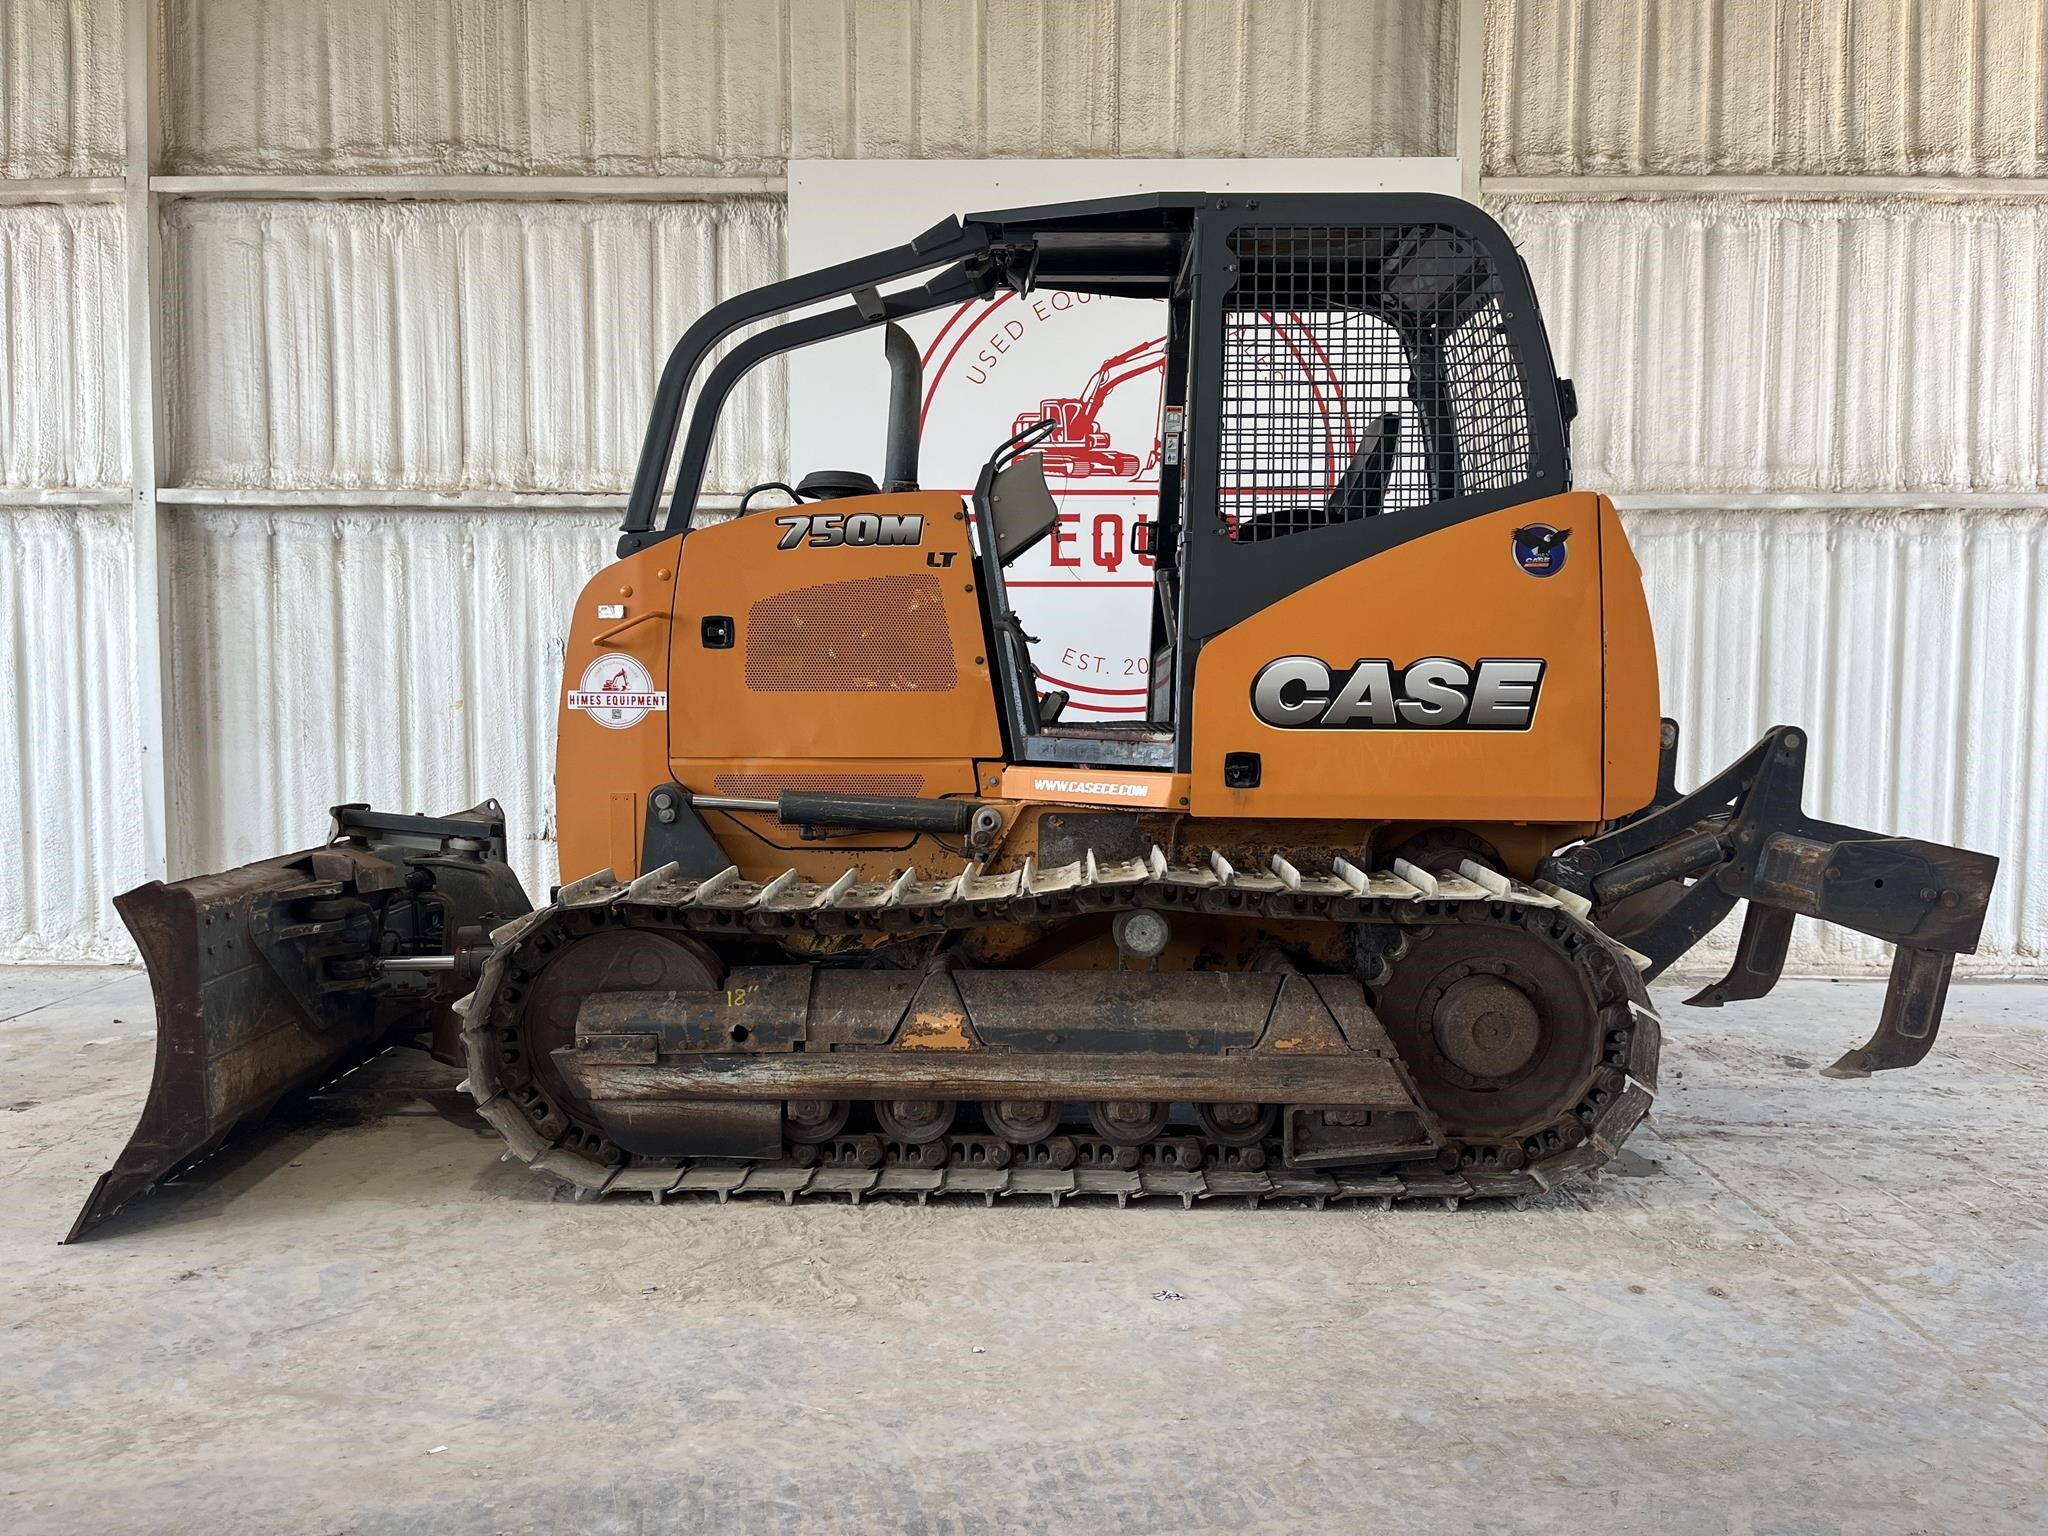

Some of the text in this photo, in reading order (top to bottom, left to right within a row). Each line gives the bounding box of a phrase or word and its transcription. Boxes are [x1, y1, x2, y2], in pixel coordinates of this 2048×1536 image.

[966, 320, 1024, 385] USED
[775, 513, 924, 549] 750M
[926, 552, 957, 568] LT
[1061, 648, 1109, 675] EST.
[569, 695, 666, 706] HIMES EQUIPMENT
[1252, 656, 1547, 729] CASE
[1034, 779, 1149, 797] WWW.CASECE.COM
